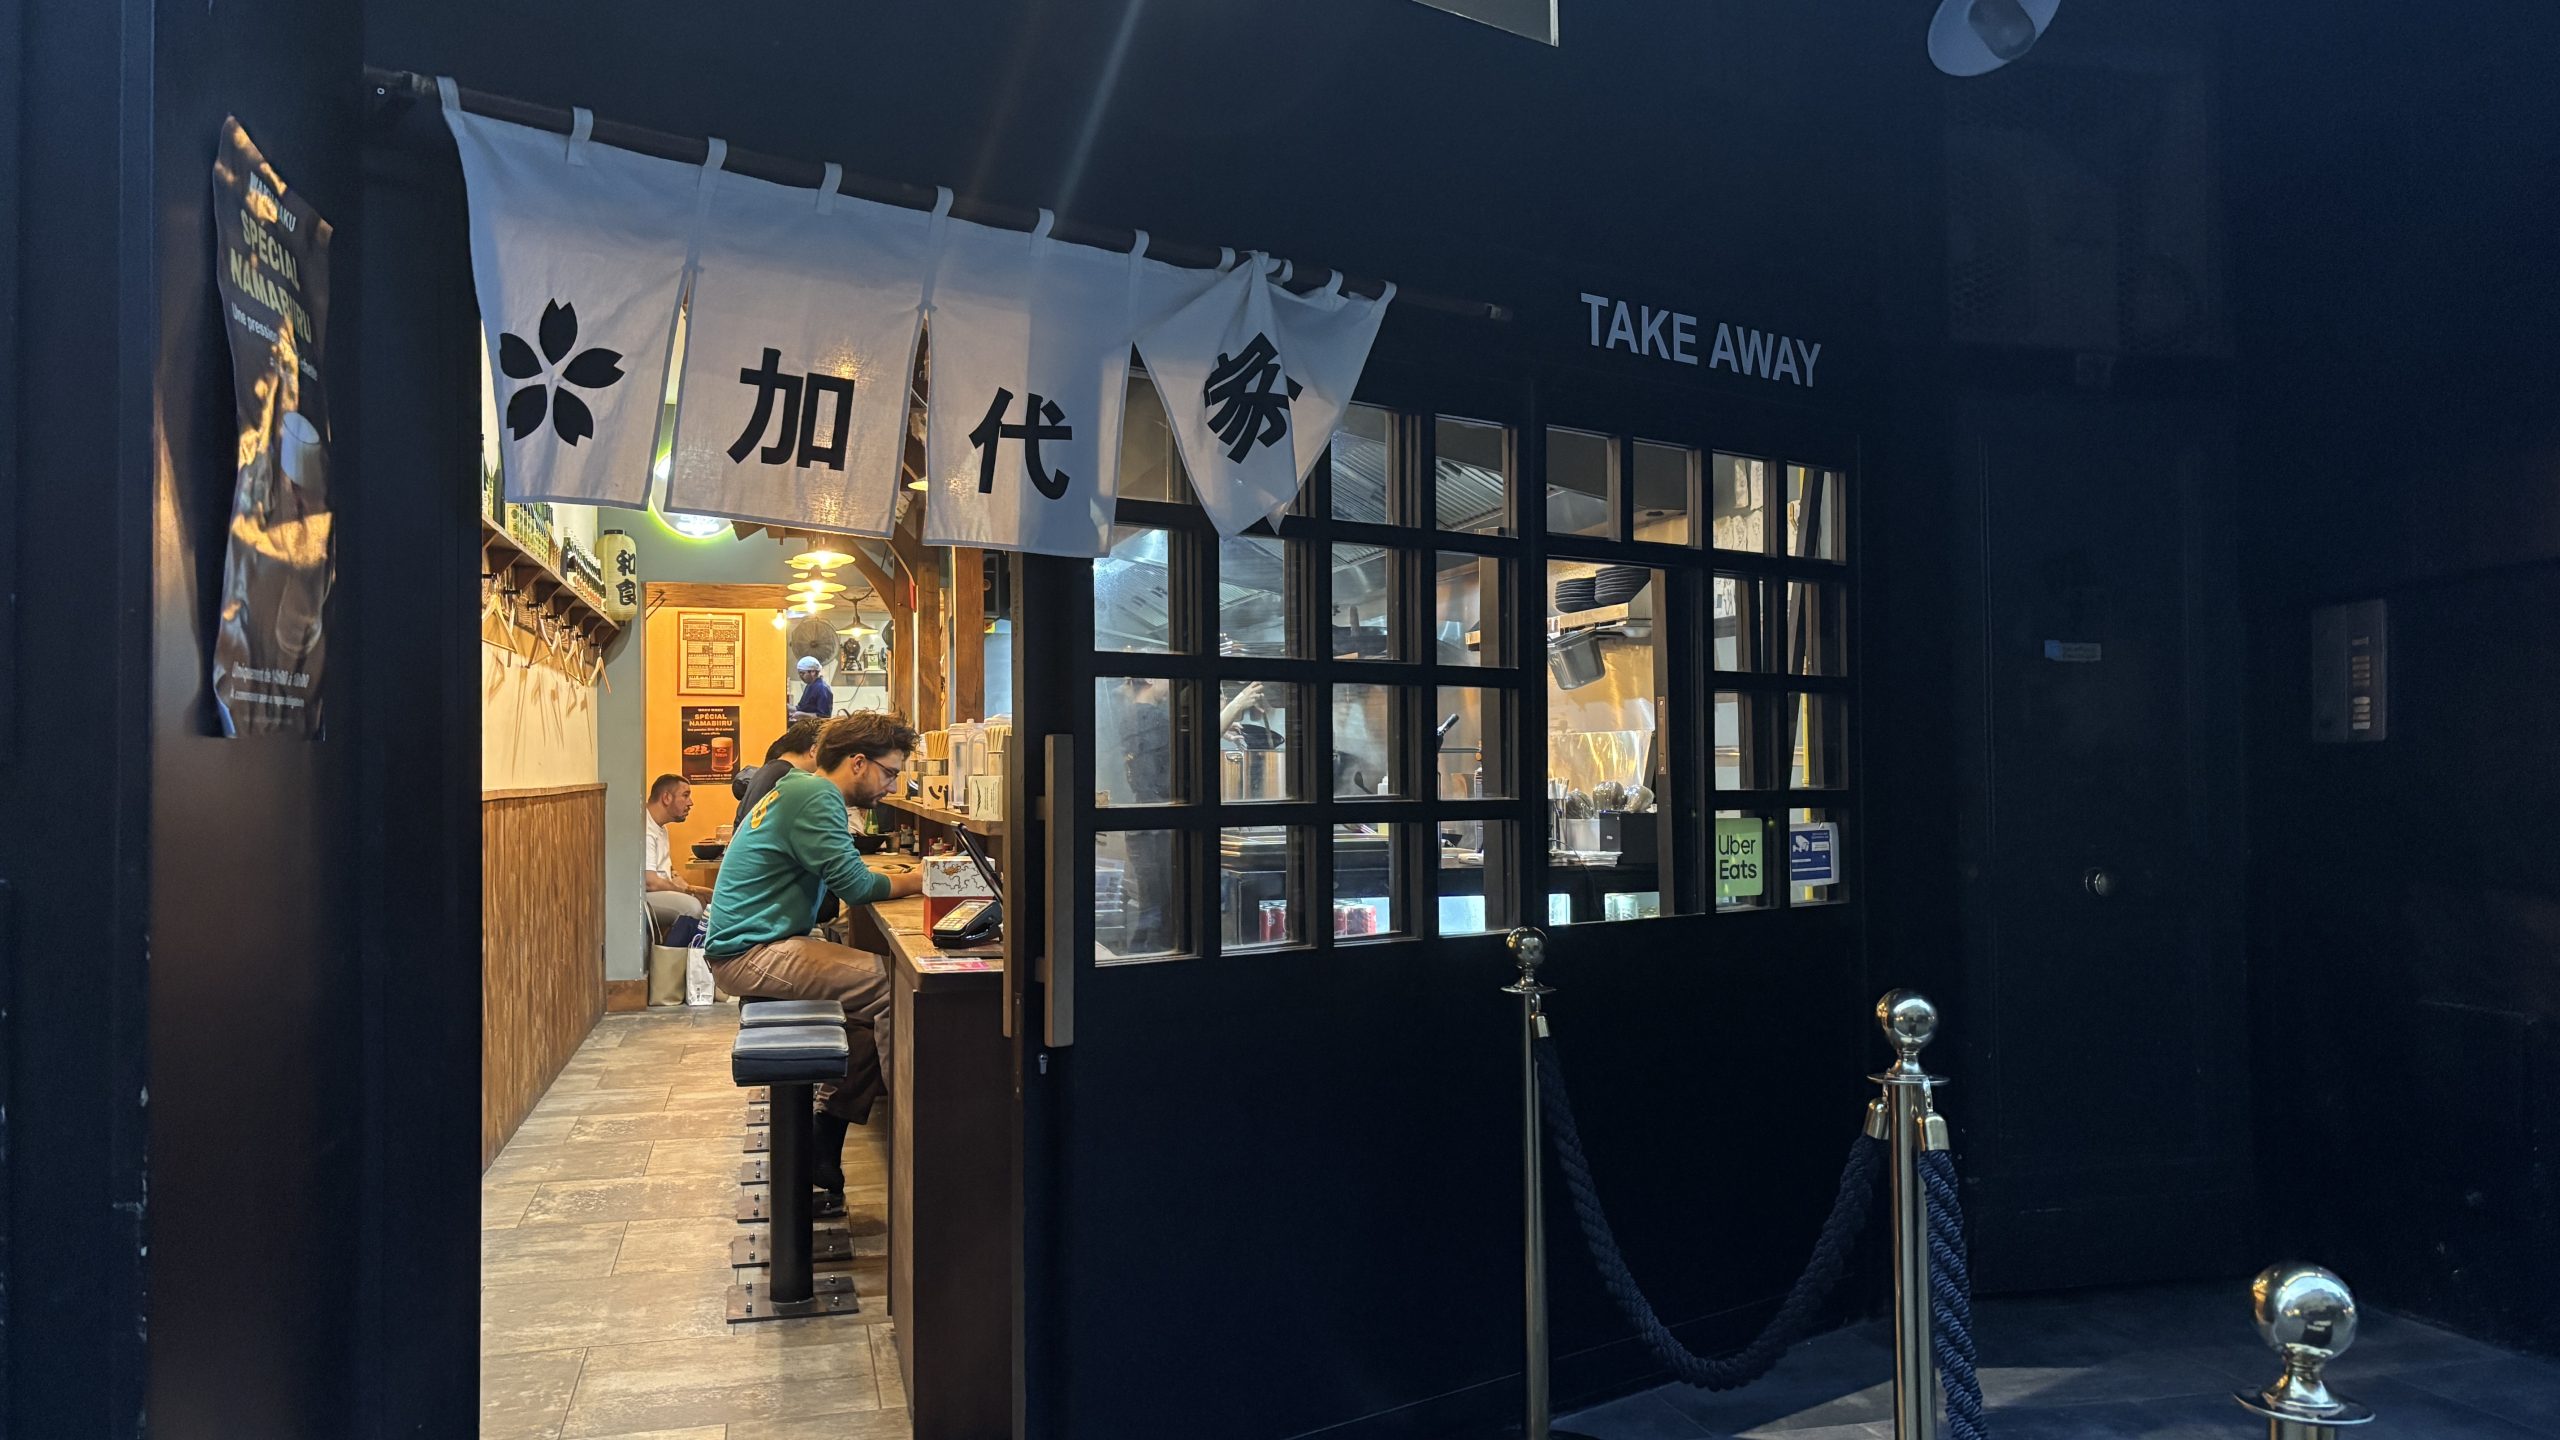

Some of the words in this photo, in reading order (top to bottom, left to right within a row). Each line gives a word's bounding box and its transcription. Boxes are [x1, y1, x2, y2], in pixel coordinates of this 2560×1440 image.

[240, 208, 301, 292] SPÉCIAL
[1580, 292, 1699, 366] TAKE
[1708, 322, 1822, 388] AWAY
[1718, 834, 1756, 855] Uber
[1719, 859, 1757, 880] Eats
